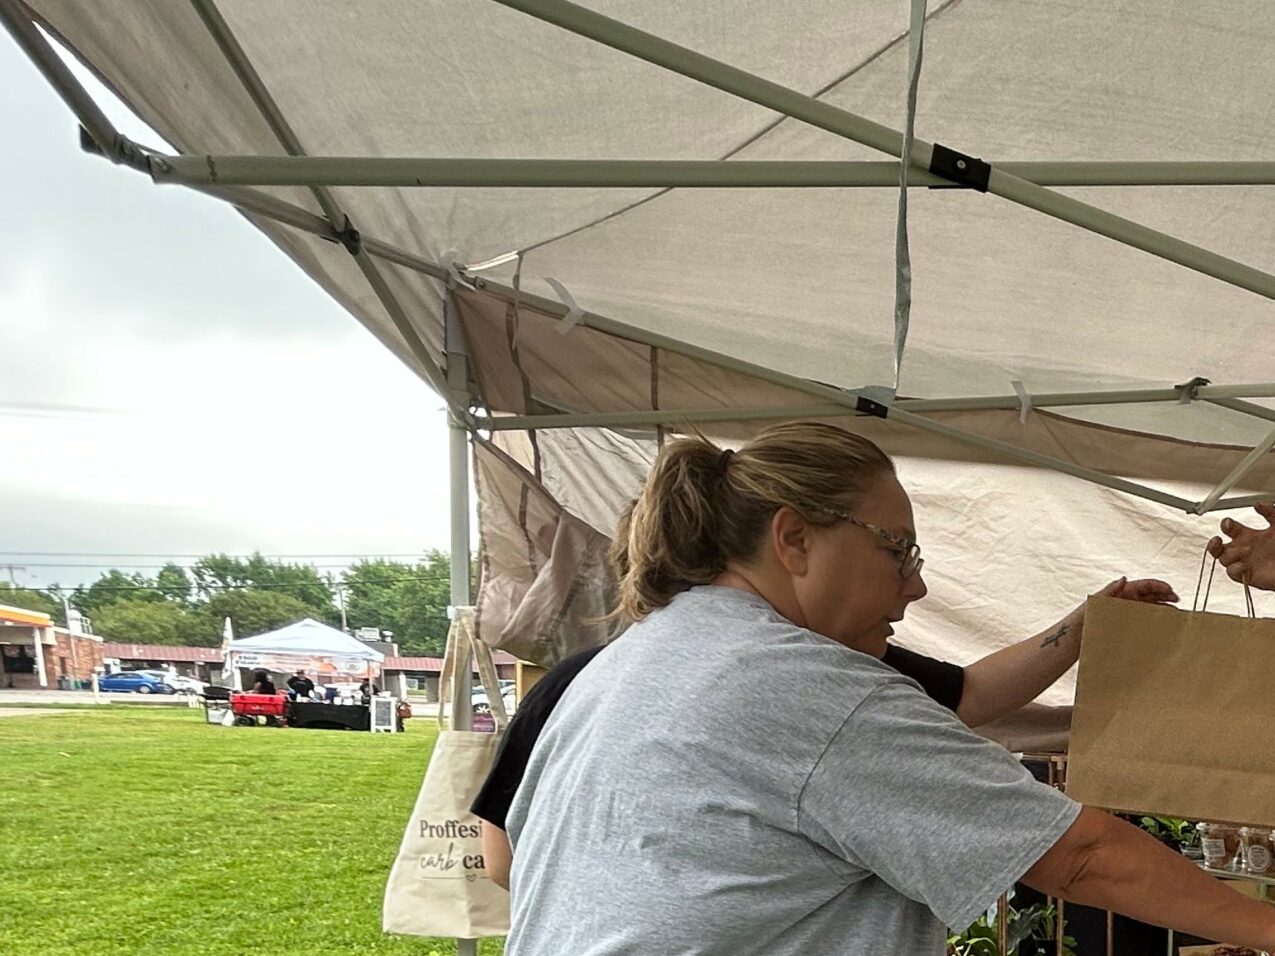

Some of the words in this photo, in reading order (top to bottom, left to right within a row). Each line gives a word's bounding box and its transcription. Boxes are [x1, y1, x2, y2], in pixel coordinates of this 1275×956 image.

[419, 819, 483, 838] Proffesi
[420, 842, 458, 871] carb
[463, 854, 485, 869] ca
